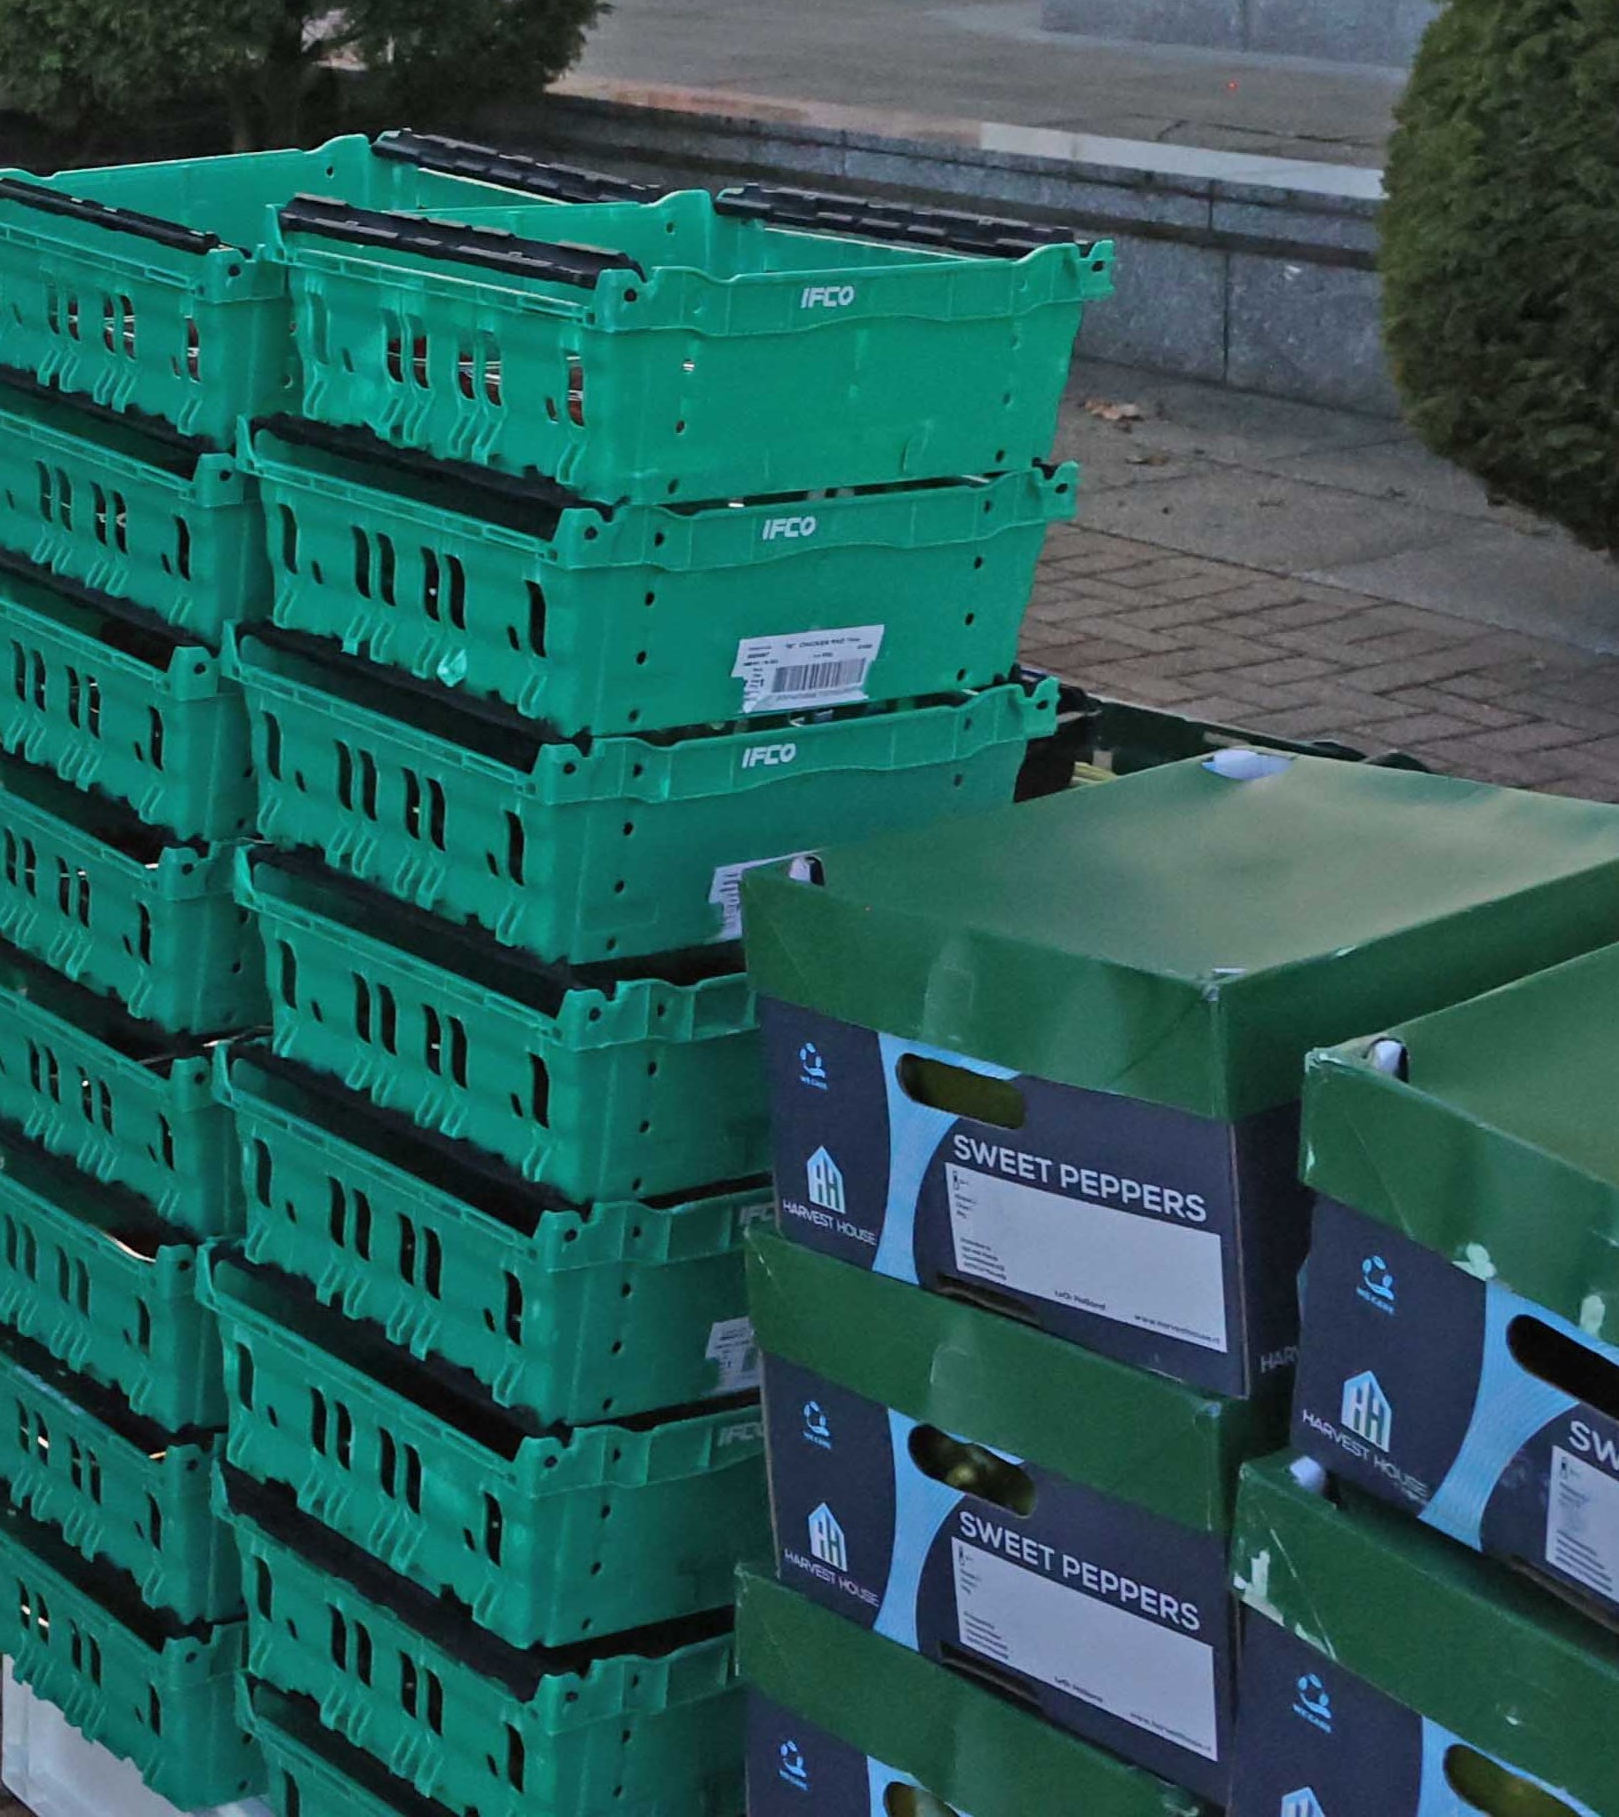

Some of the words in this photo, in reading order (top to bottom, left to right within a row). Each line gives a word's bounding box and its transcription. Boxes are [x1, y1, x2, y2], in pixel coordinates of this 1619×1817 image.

[801, 285, 855, 309] IFCO
[762, 516, 817, 541] IFCO
[741, 743, 797, 769] IFCO
[953, 1134, 1052, 1183] SWEET
[1060, 1163, 1208, 1222] PEPPERS
[739, 1203, 774, 1225] IFC
[782, 1198, 834, 1230] HARVEST
[836, 1216, 877, 1247] HOUSE
[1302, 1409, 1371, 1462] HARVEST
[1373, 1452, 1429, 1498] HOUSE
[784, 1548, 836, 1584] HARVEST
[837, 1576, 880, 1608] HOUSE
[960, 1510, 1055, 1571] SWEET
[1062, 1554, 1201, 1631] PEPPERS
